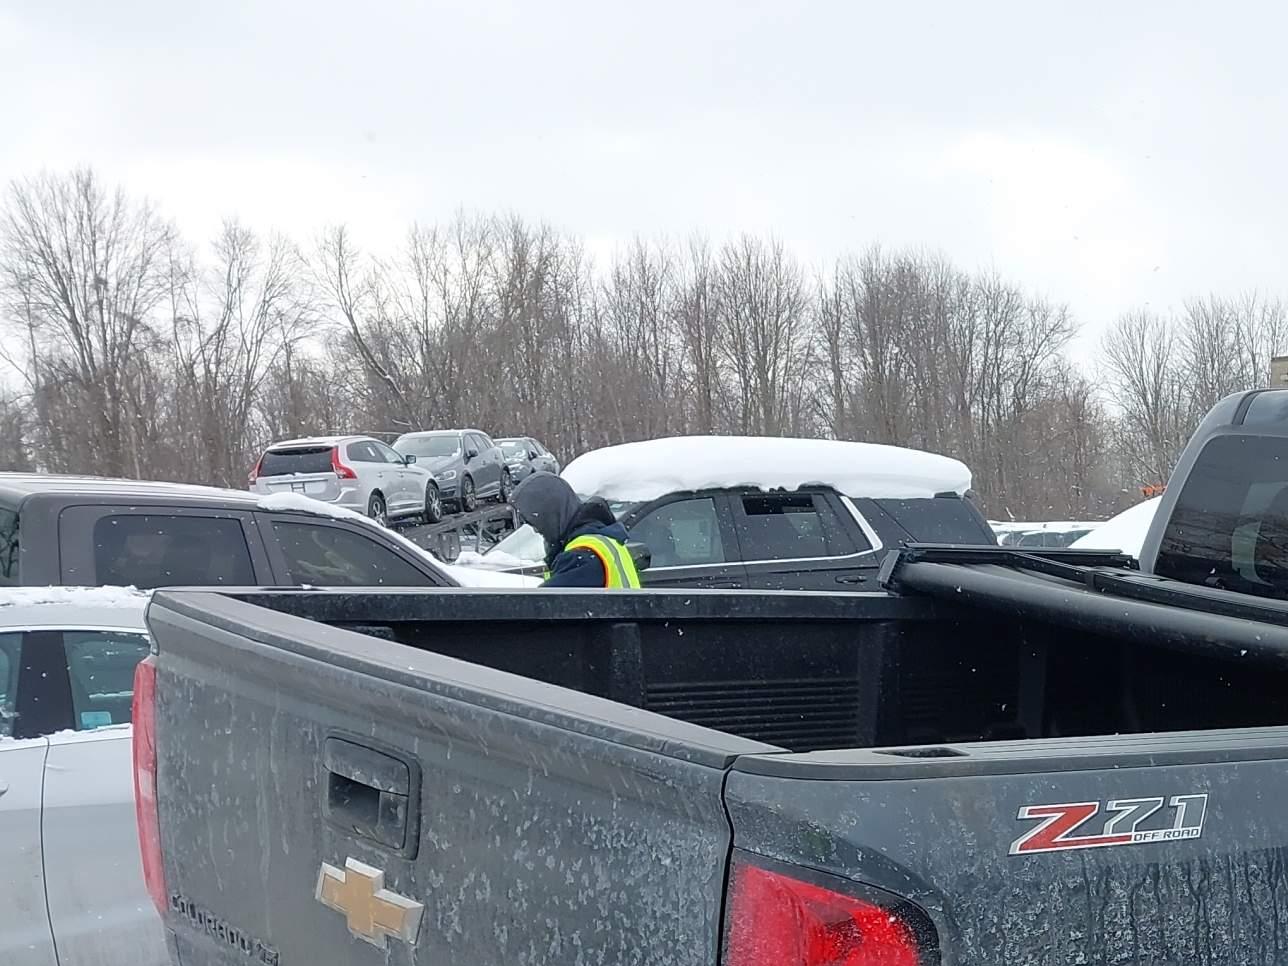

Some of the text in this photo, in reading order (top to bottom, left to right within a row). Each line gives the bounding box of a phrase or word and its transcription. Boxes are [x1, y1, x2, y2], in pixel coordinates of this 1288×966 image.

[1007, 793, 1208, 855] Z71
[1133, 828, 1200, 842] OFF ROAD
